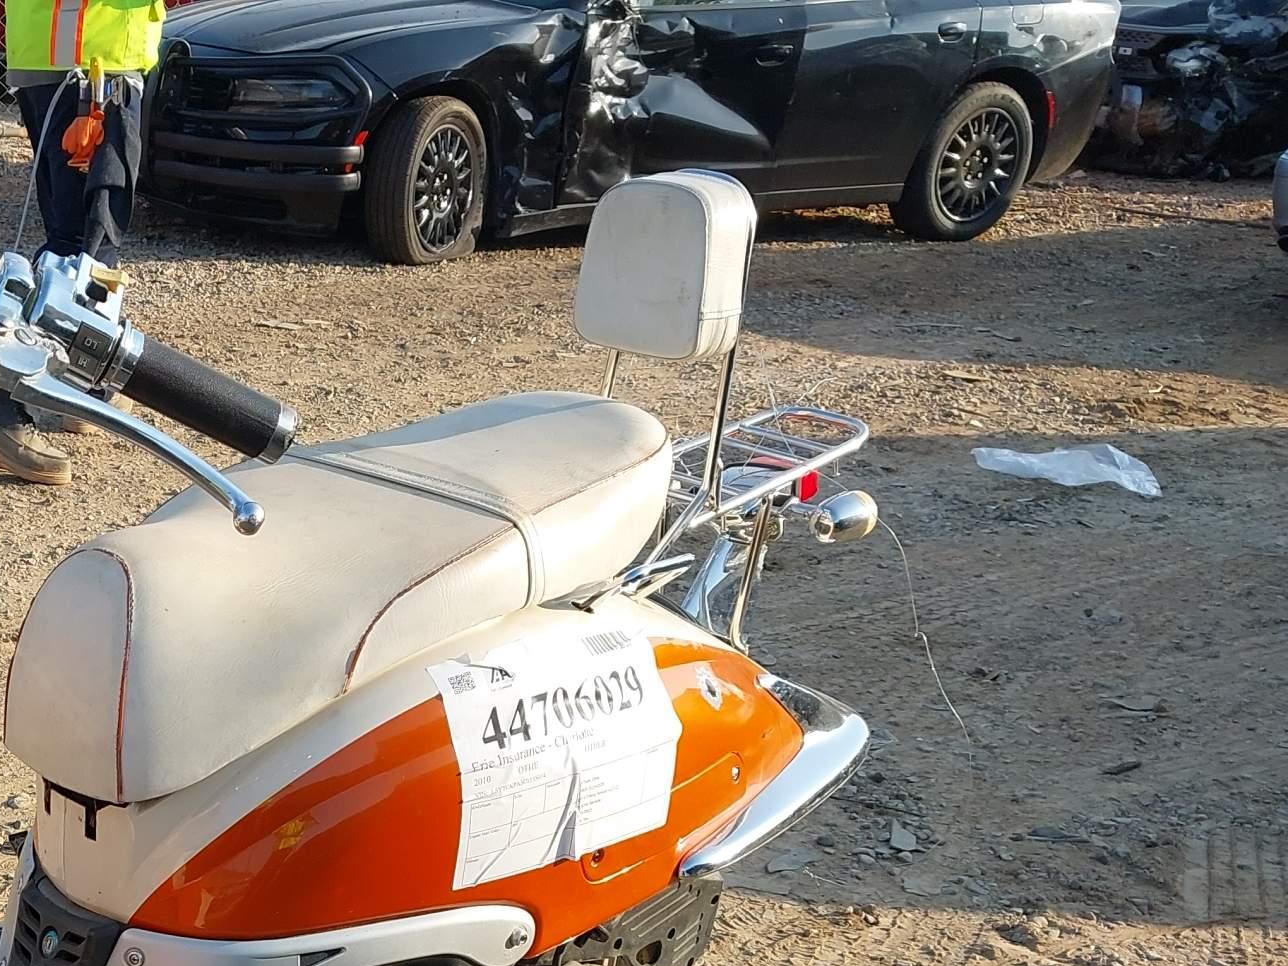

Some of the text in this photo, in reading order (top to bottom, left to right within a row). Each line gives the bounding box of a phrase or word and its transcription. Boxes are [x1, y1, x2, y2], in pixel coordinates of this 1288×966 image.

[481, 665, 644, 750] 44706029
[471, 758, 496, 773] Erie
[497, 743, 546, 767] Insurance
[473, 775, 492, 787] 2010
